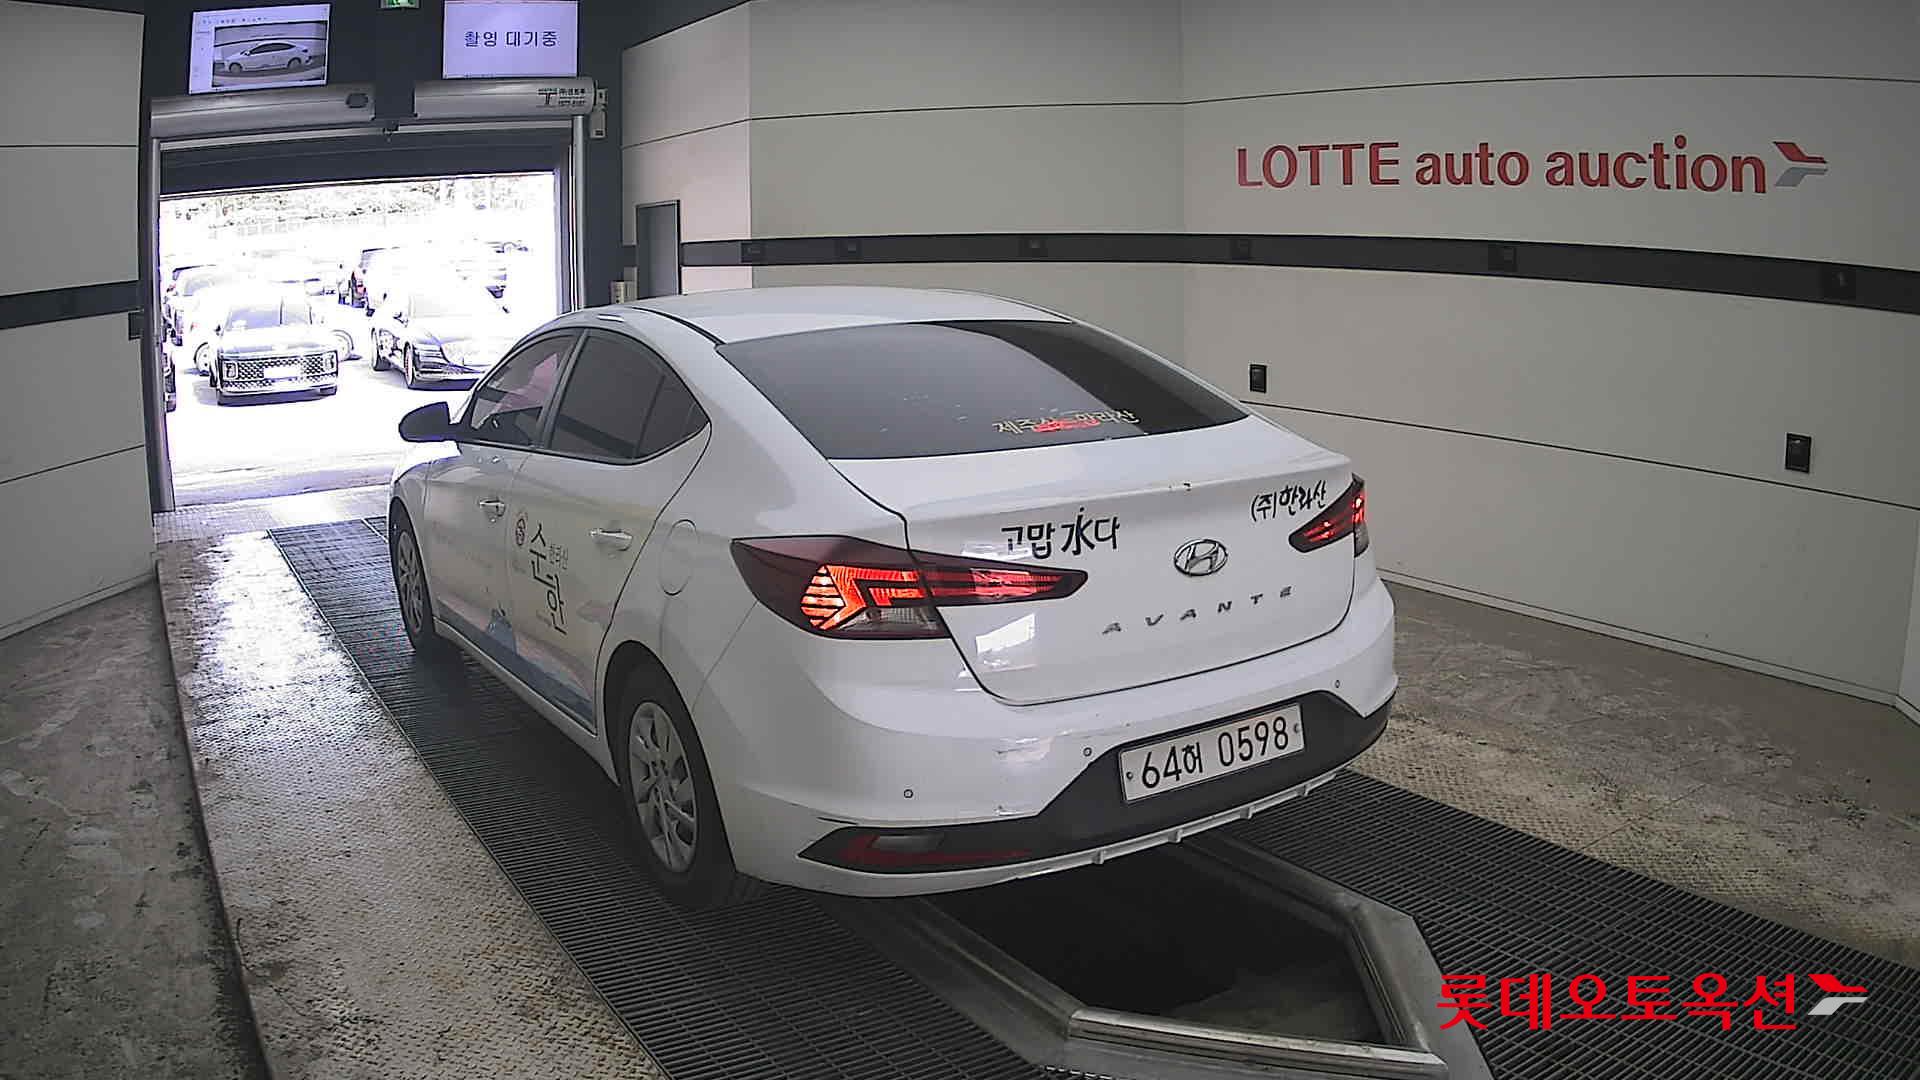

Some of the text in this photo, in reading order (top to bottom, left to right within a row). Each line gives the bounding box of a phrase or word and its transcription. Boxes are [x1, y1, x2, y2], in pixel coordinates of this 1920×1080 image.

[465, 31, 497, 47] 촬영
[1237, 135, 1767, 194] LOTTE auto auction
[1102, 585, 1293, 635] AVANTE
[1141, 715, 1290, 789] 64허 0598
